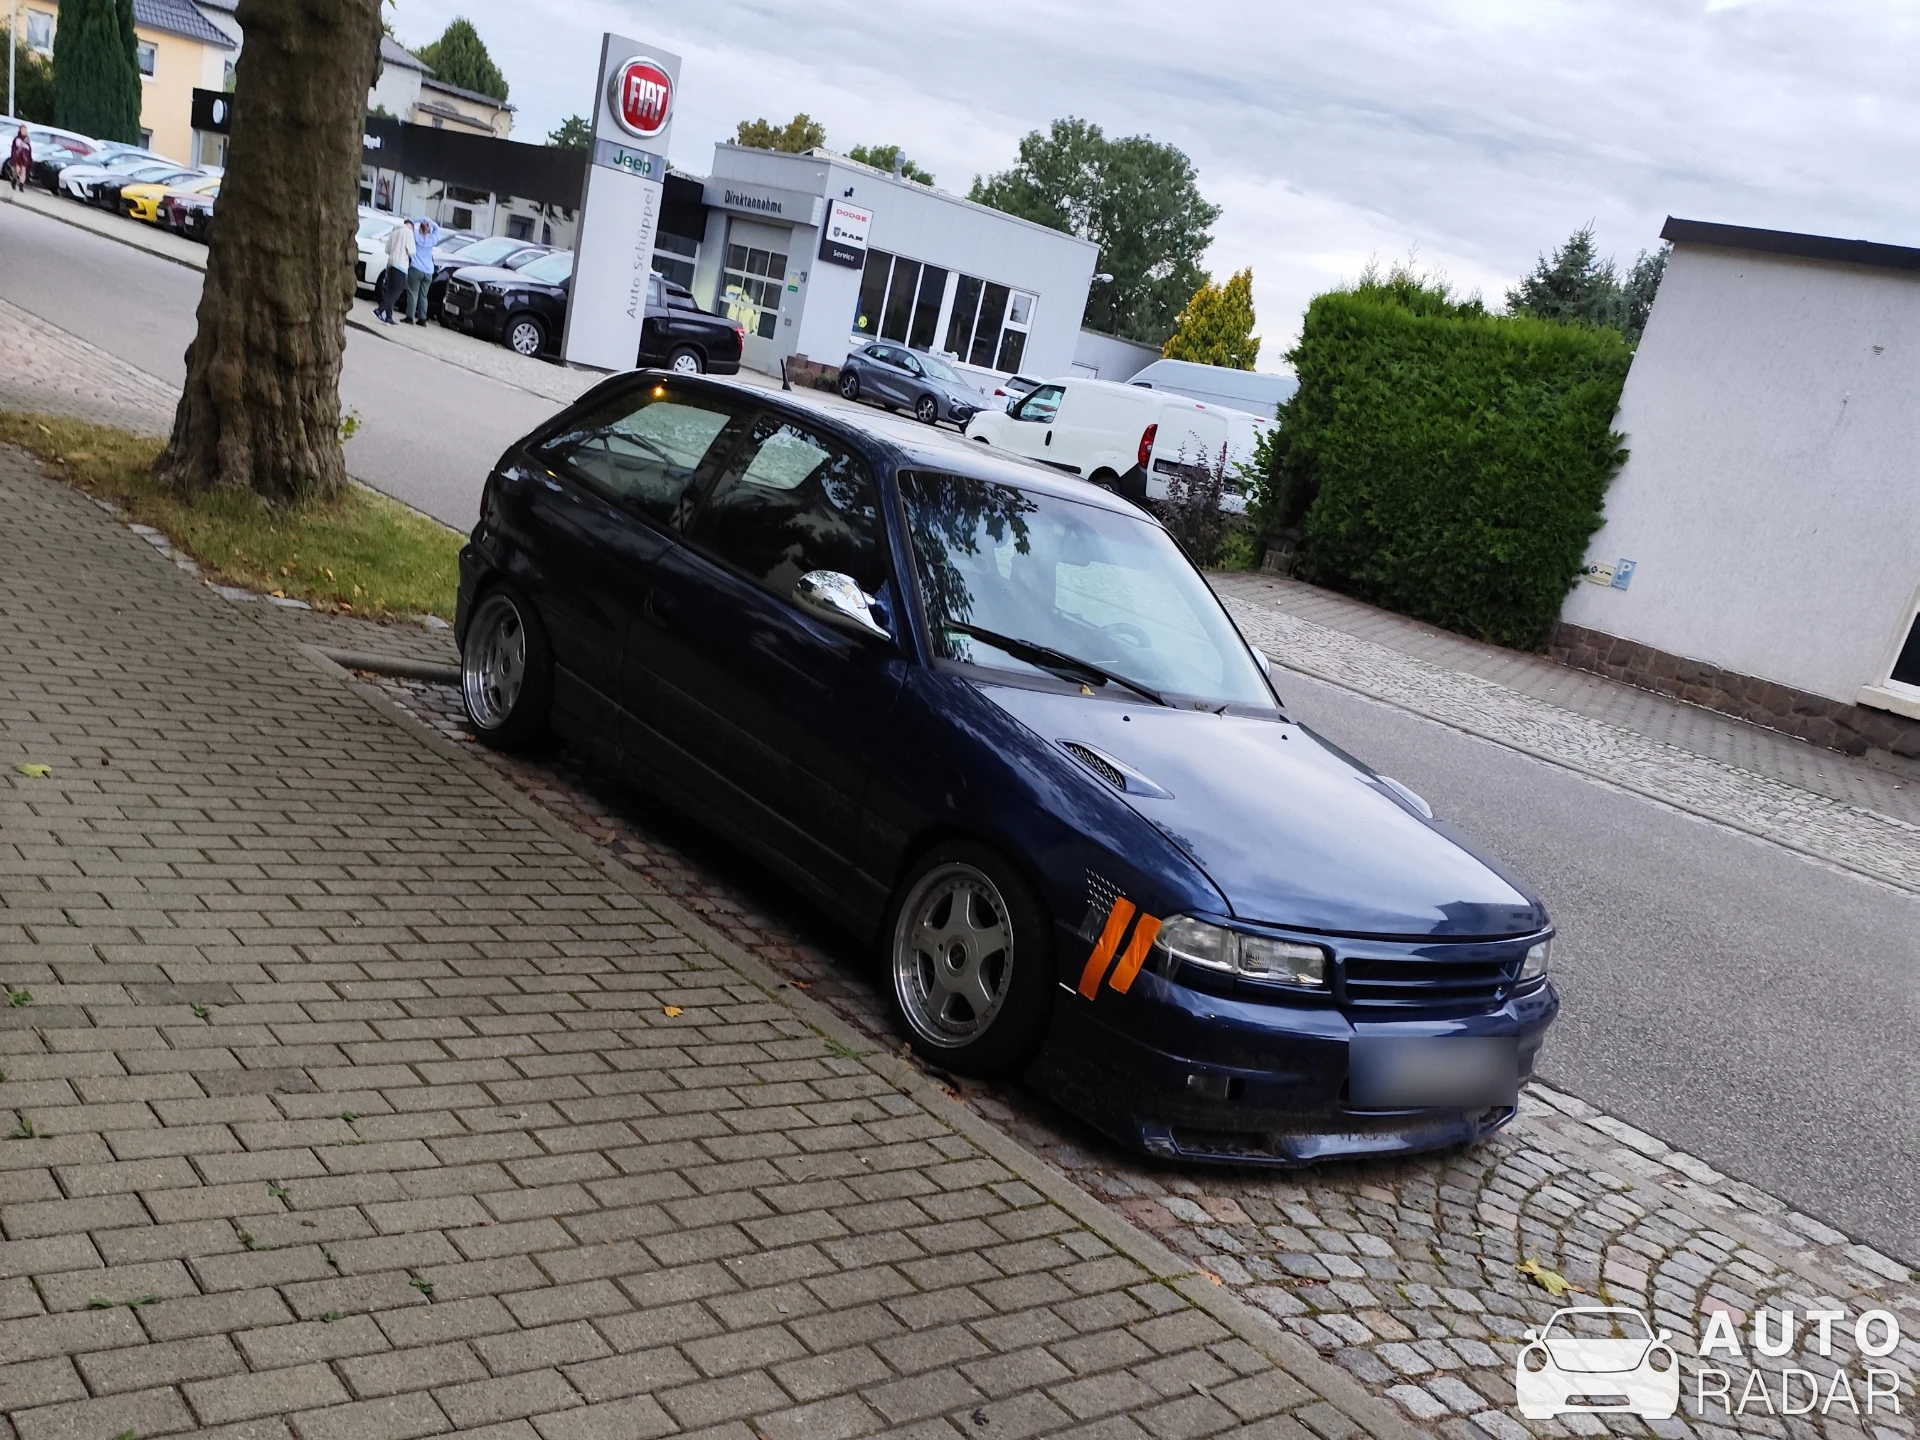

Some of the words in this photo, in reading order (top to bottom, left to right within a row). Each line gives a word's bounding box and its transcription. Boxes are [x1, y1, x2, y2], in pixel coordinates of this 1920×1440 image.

[627, 75, 667, 121] FIAT
[613, 149, 652, 176] Jeep
[725, 189, 782, 213] Direktannahme
[836, 208, 868, 223] DODGE
[633, 187, 655, 272] Schüppel
[841, 231, 864, 242] RAM
[833, 249, 856, 262] Service
[626, 278, 641, 320] Auto
[1619, 563, 1632, 576] P
